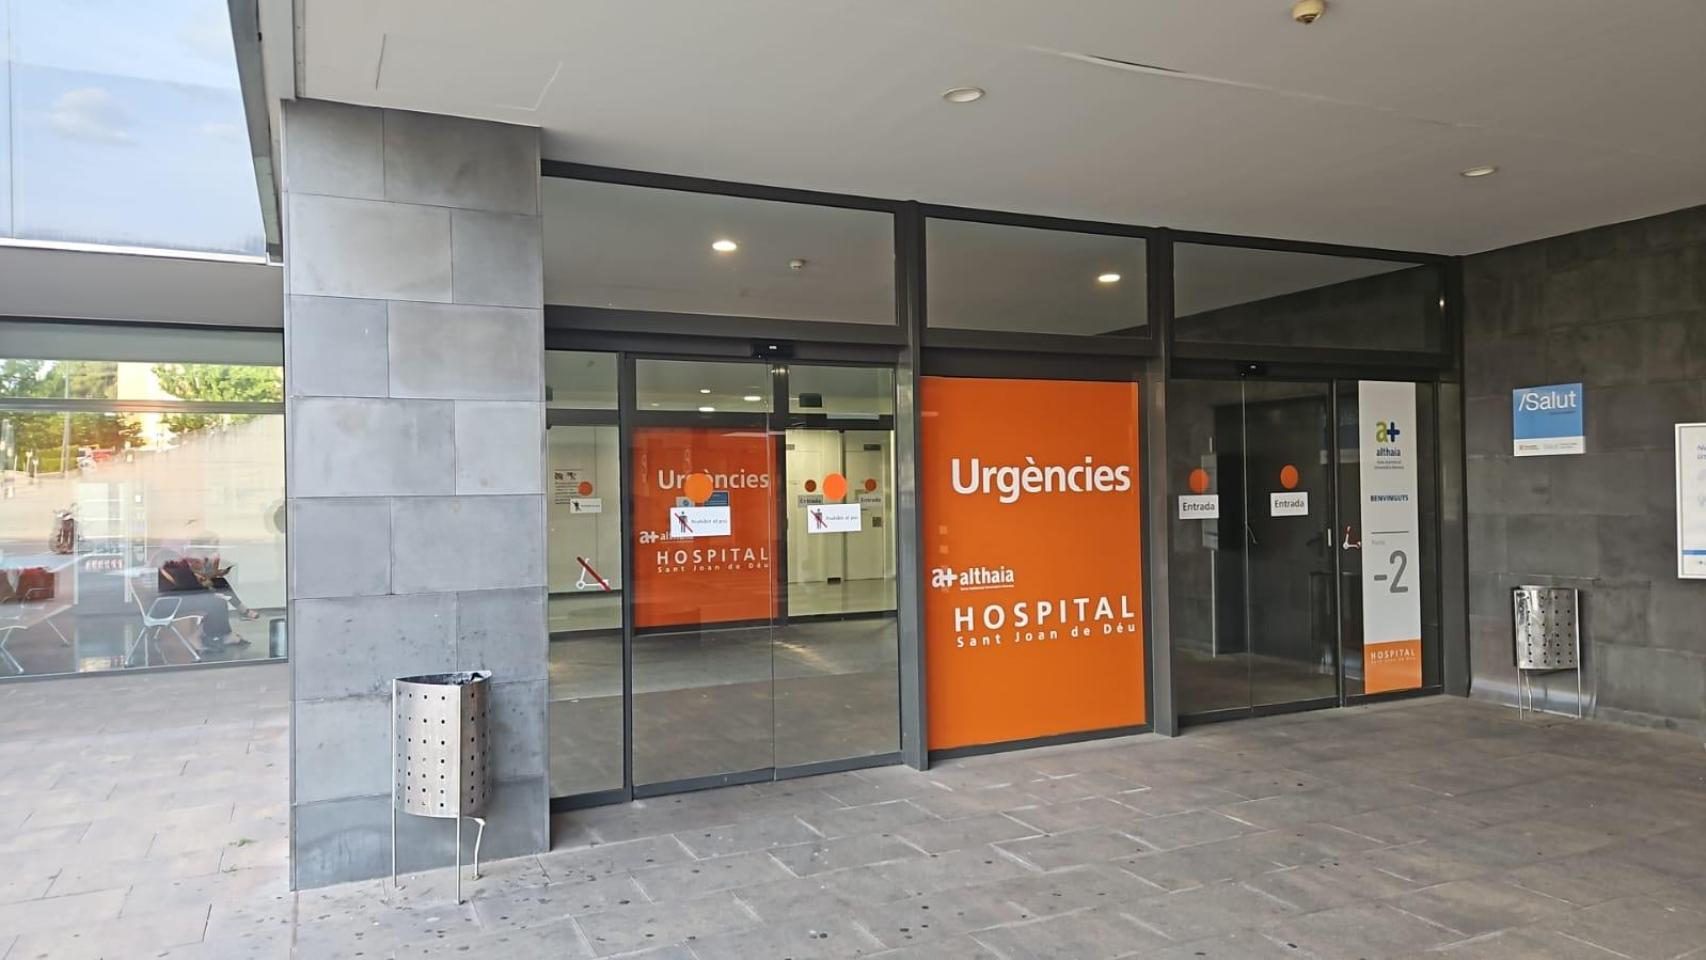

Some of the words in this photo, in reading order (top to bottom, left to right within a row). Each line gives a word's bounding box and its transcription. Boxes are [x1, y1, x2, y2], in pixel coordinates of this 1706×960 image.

[1518, 390, 1577, 411] /Salut
[658, 469, 769, 489] Urncies
[951, 456, 1132, 504] Urgències
[1182, 501, 1216, 512] Entrada
[1274, 499, 1305, 509] Entrada
[1370, 494, 1409, 502] BENVINGUTS
[656, 547, 769, 566] HOSPITAL
[657, 565, 686, 574] Sant
[693, 563, 721, 572] Joan
[727, 563, 741, 571] de
[959, 565, 1015, 586] althaia
[1373, 549, 1409, 593] -2
[954, 595, 1135, 633] HOSPITAL
[956, 633, 1001, 648] Sant
[1014, 628, 1058, 643] Joan
[1071, 625, 1091, 638] de
[1103, 620, 1136, 635] Déu
[1370, 648, 1416, 660] HOSPITAL
